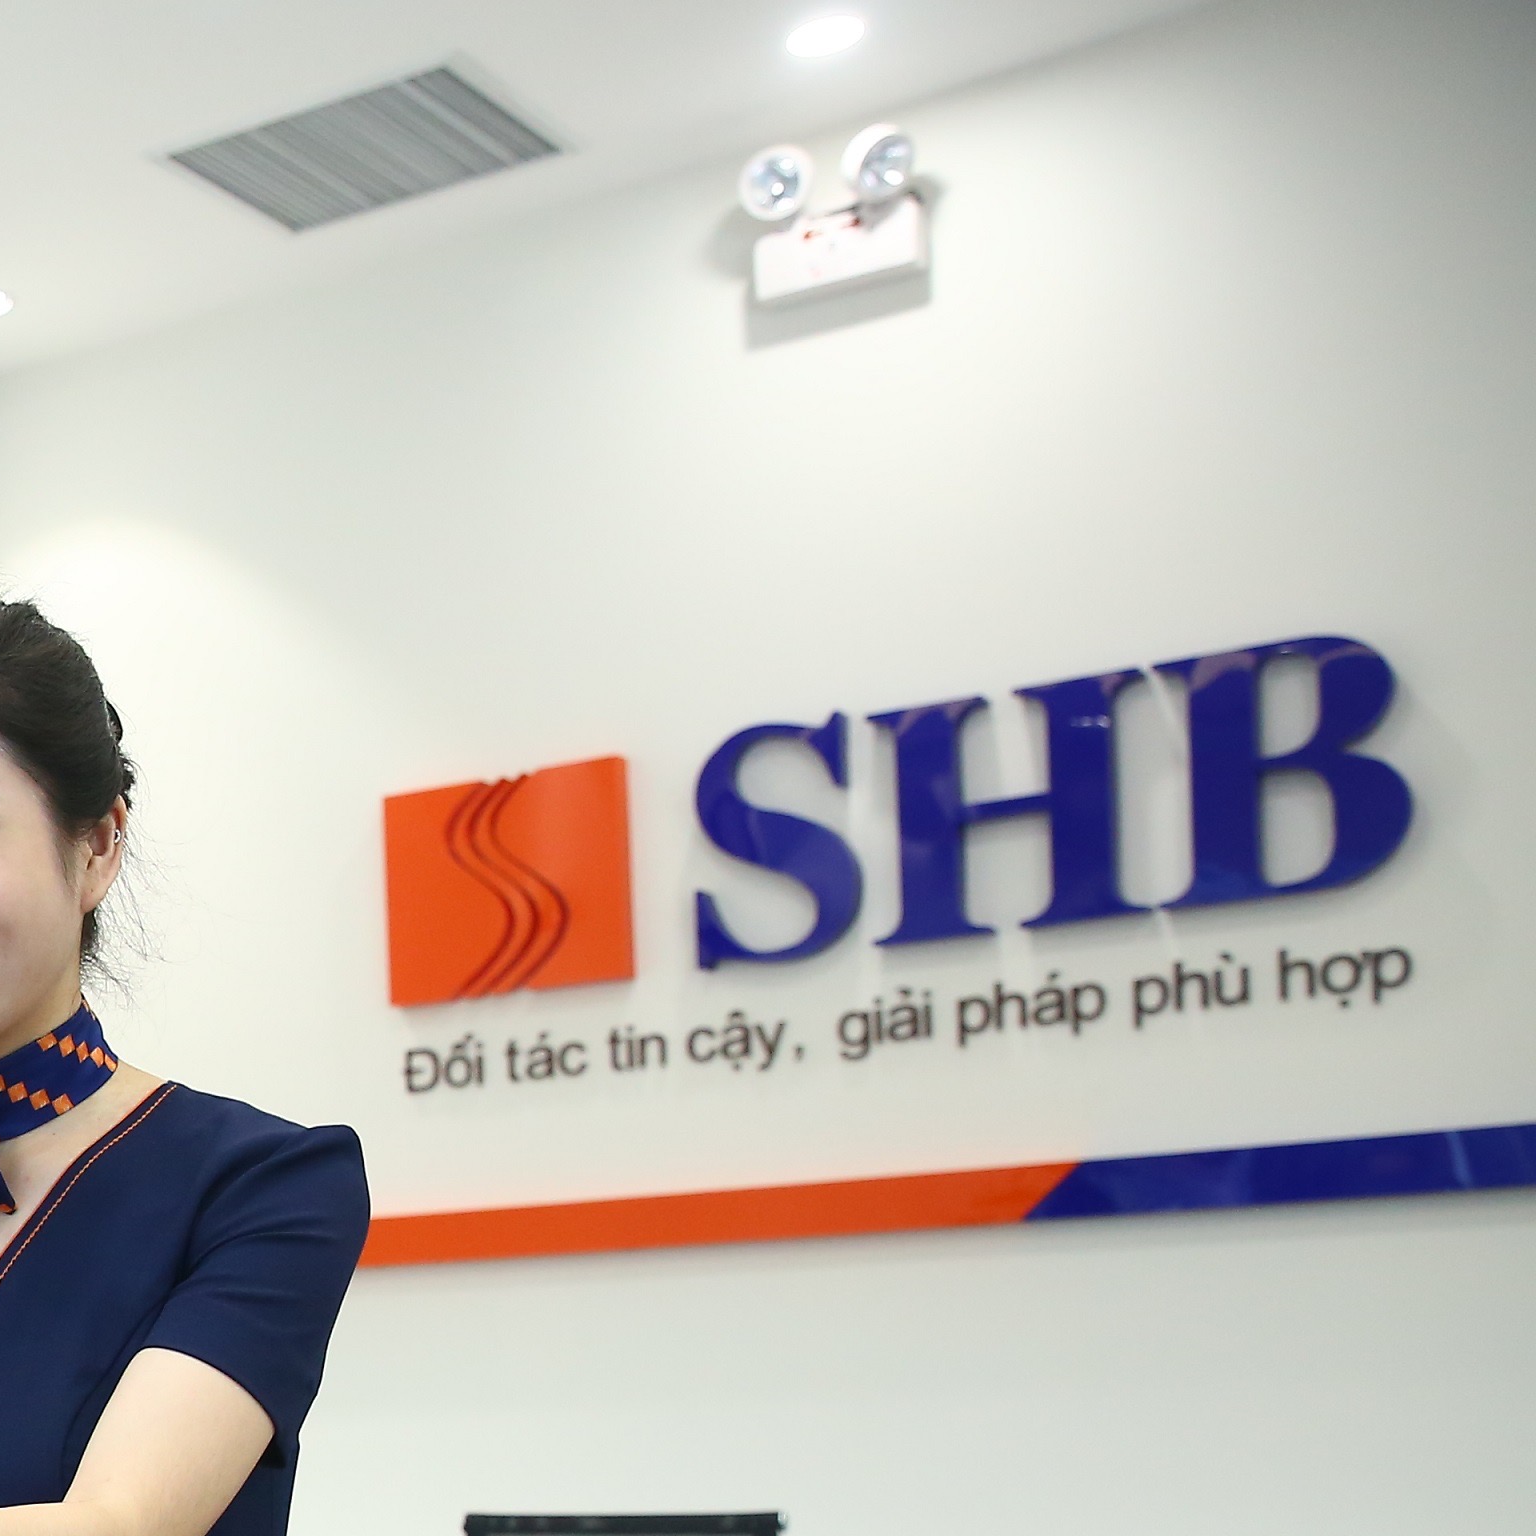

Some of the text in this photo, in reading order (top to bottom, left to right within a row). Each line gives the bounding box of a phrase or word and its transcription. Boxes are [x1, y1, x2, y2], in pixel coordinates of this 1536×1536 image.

[694, 634, 1416, 972] SHB
[405, 945, 1414, 1094] Đối tác tin cậy, giải pháp phù hợp
